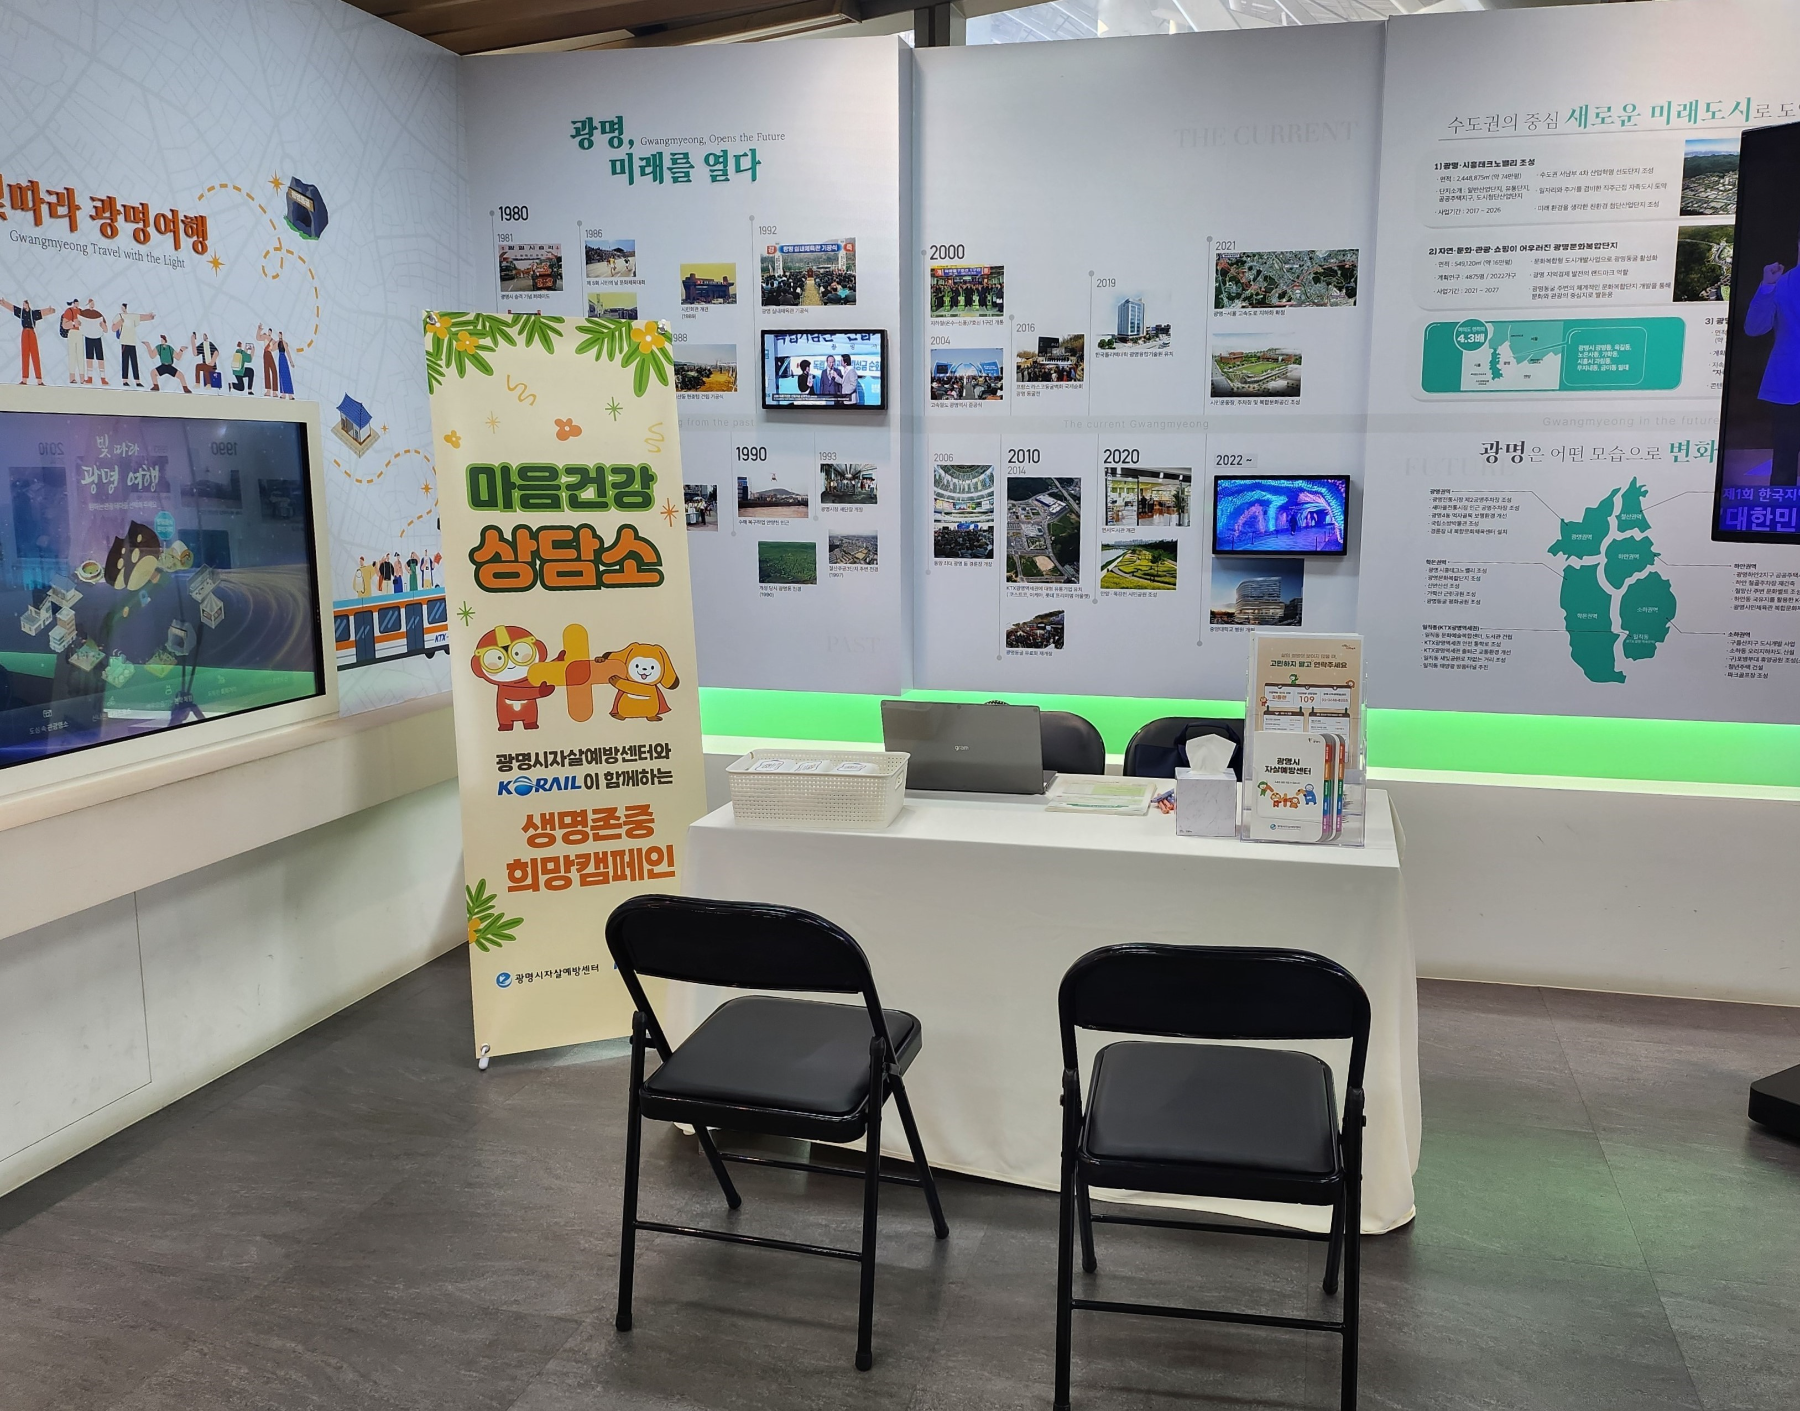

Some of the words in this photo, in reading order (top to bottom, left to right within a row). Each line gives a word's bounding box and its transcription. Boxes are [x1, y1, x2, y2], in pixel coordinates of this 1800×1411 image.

[1447, 113, 1518, 135] 수도권의
[1524, 111, 1559, 131] 중심
[1565, 103, 1642, 130] 새로운
[1650, 96, 1773, 126] 미래도시로
[1777, 102, 1800, 118] 도
[640, 136, 707, 148] Gwangmyeong,
[709, 134, 737, 146] Opens
[739, 132, 754, 142] the
[756, 132, 786, 142] Future
[1174, 127, 1226, 148] THE
[1233, 121, 1359, 146] CURRENT
[609, 151, 695, 186] 미래를
[703, 148, 762, 183] 열다
[1519, 158, 1536, 167] 조성
[1578, 169, 1589, 177] 4차
[1642, 166, 1654, 174] 조성
[1539, 186, 1563, 194] 일자리와
[1438, 208, 1461, 216] 사업기간
[1570, 203, 1588, 211] 생각한
[0, 173, 82, 233] 따라
[89, 195, 209, 256] 광명여행
[498, 205, 529, 222] 1980
[585, 229, 603, 238] 1986
[759, 225, 778, 235] 1992
[497, 233, 514, 243] 1981
[9, 229, 88, 256] Gwangmyeong
[91, 242, 121, 257] Travel
[124, 247, 144, 262] with
[146, 252, 161, 263] the
[163, 254, 186, 270] Light
[1215, 241, 1237, 251] 2021
[1519, 243, 1552, 252] 어우러진
[929, 244, 966, 260] 2000
[1533, 270, 1545, 278] 광명
[1096, 278, 1116, 288] 2019
[1531, 292, 1549, 300] 문화와
[1016, 323, 1036, 333] 2016
[672, 333, 688, 343] 988
[930, 336, 951, 346] 2004
[1457, 333, 1485, 343] 4.3배
[687, 418, 710, 427] from
[712, 418, 729, 427] the
[732, 418, 755, 429] past
[1063, 419, 1083, 429] The
[1086, 419, 1126, 429] current
[1129, 419, 1210, 431] Gwangmyeong
[1542, 416, 1635, 428] Gwangmyeong
[1639, 416, 1651, 426] in
[1654, 416, 1676, 426] the
[1681, 415, 1720, 426] future
[96, 433, 112, 459] 빛
[113, 440, 140, 457] 따라
[736, 446, 768, 462] 1990
[819, 451, 837, 461] 1993
[1007, 448, 1041, 464] 2010
[1103, 448, 1140, 464] 2020
[1479, 440, 1544, 464] 광명은
[1549, 445, 1584, 463] 어떤
[1589, 445, 1662, 463] 모습으로
[933, 453, 954, 463] 2006
[1216, 454, 1243, 466] 2022
[1007, 465, 1027, 475] 2014
[80, 464, 120, 494] 광명
[126, 464, 160, 493] 여행
[466, 462, 658, 513] 마음건강
[1723, 487, 1754, 501] 제1회
[1757, 487, 1800, 502] 한국지
[468, 523, 665, 593] 상담소
[434, 632, 447, 644] KTX
[1270, 659, 1297, 668] 고민하지
[1313, 661, 1348, 669] 연락주세요
[1299, 695, 1315, 704] 109
[954, 744, 969, 752] gram
[495, 742, 672, 773] 광명시자살예방센터와
[1276, 757, 1301, 766] 광명시
[1264, 765, 1312, 775] 자살예방센터
[603, 767, 673, 790] 함께하는
[521, 803, 655, 849] 생명존중
[506, 844, 676, 893] 희망캠페인
[515, 963, 600, 984] 광명시자살예방센터
